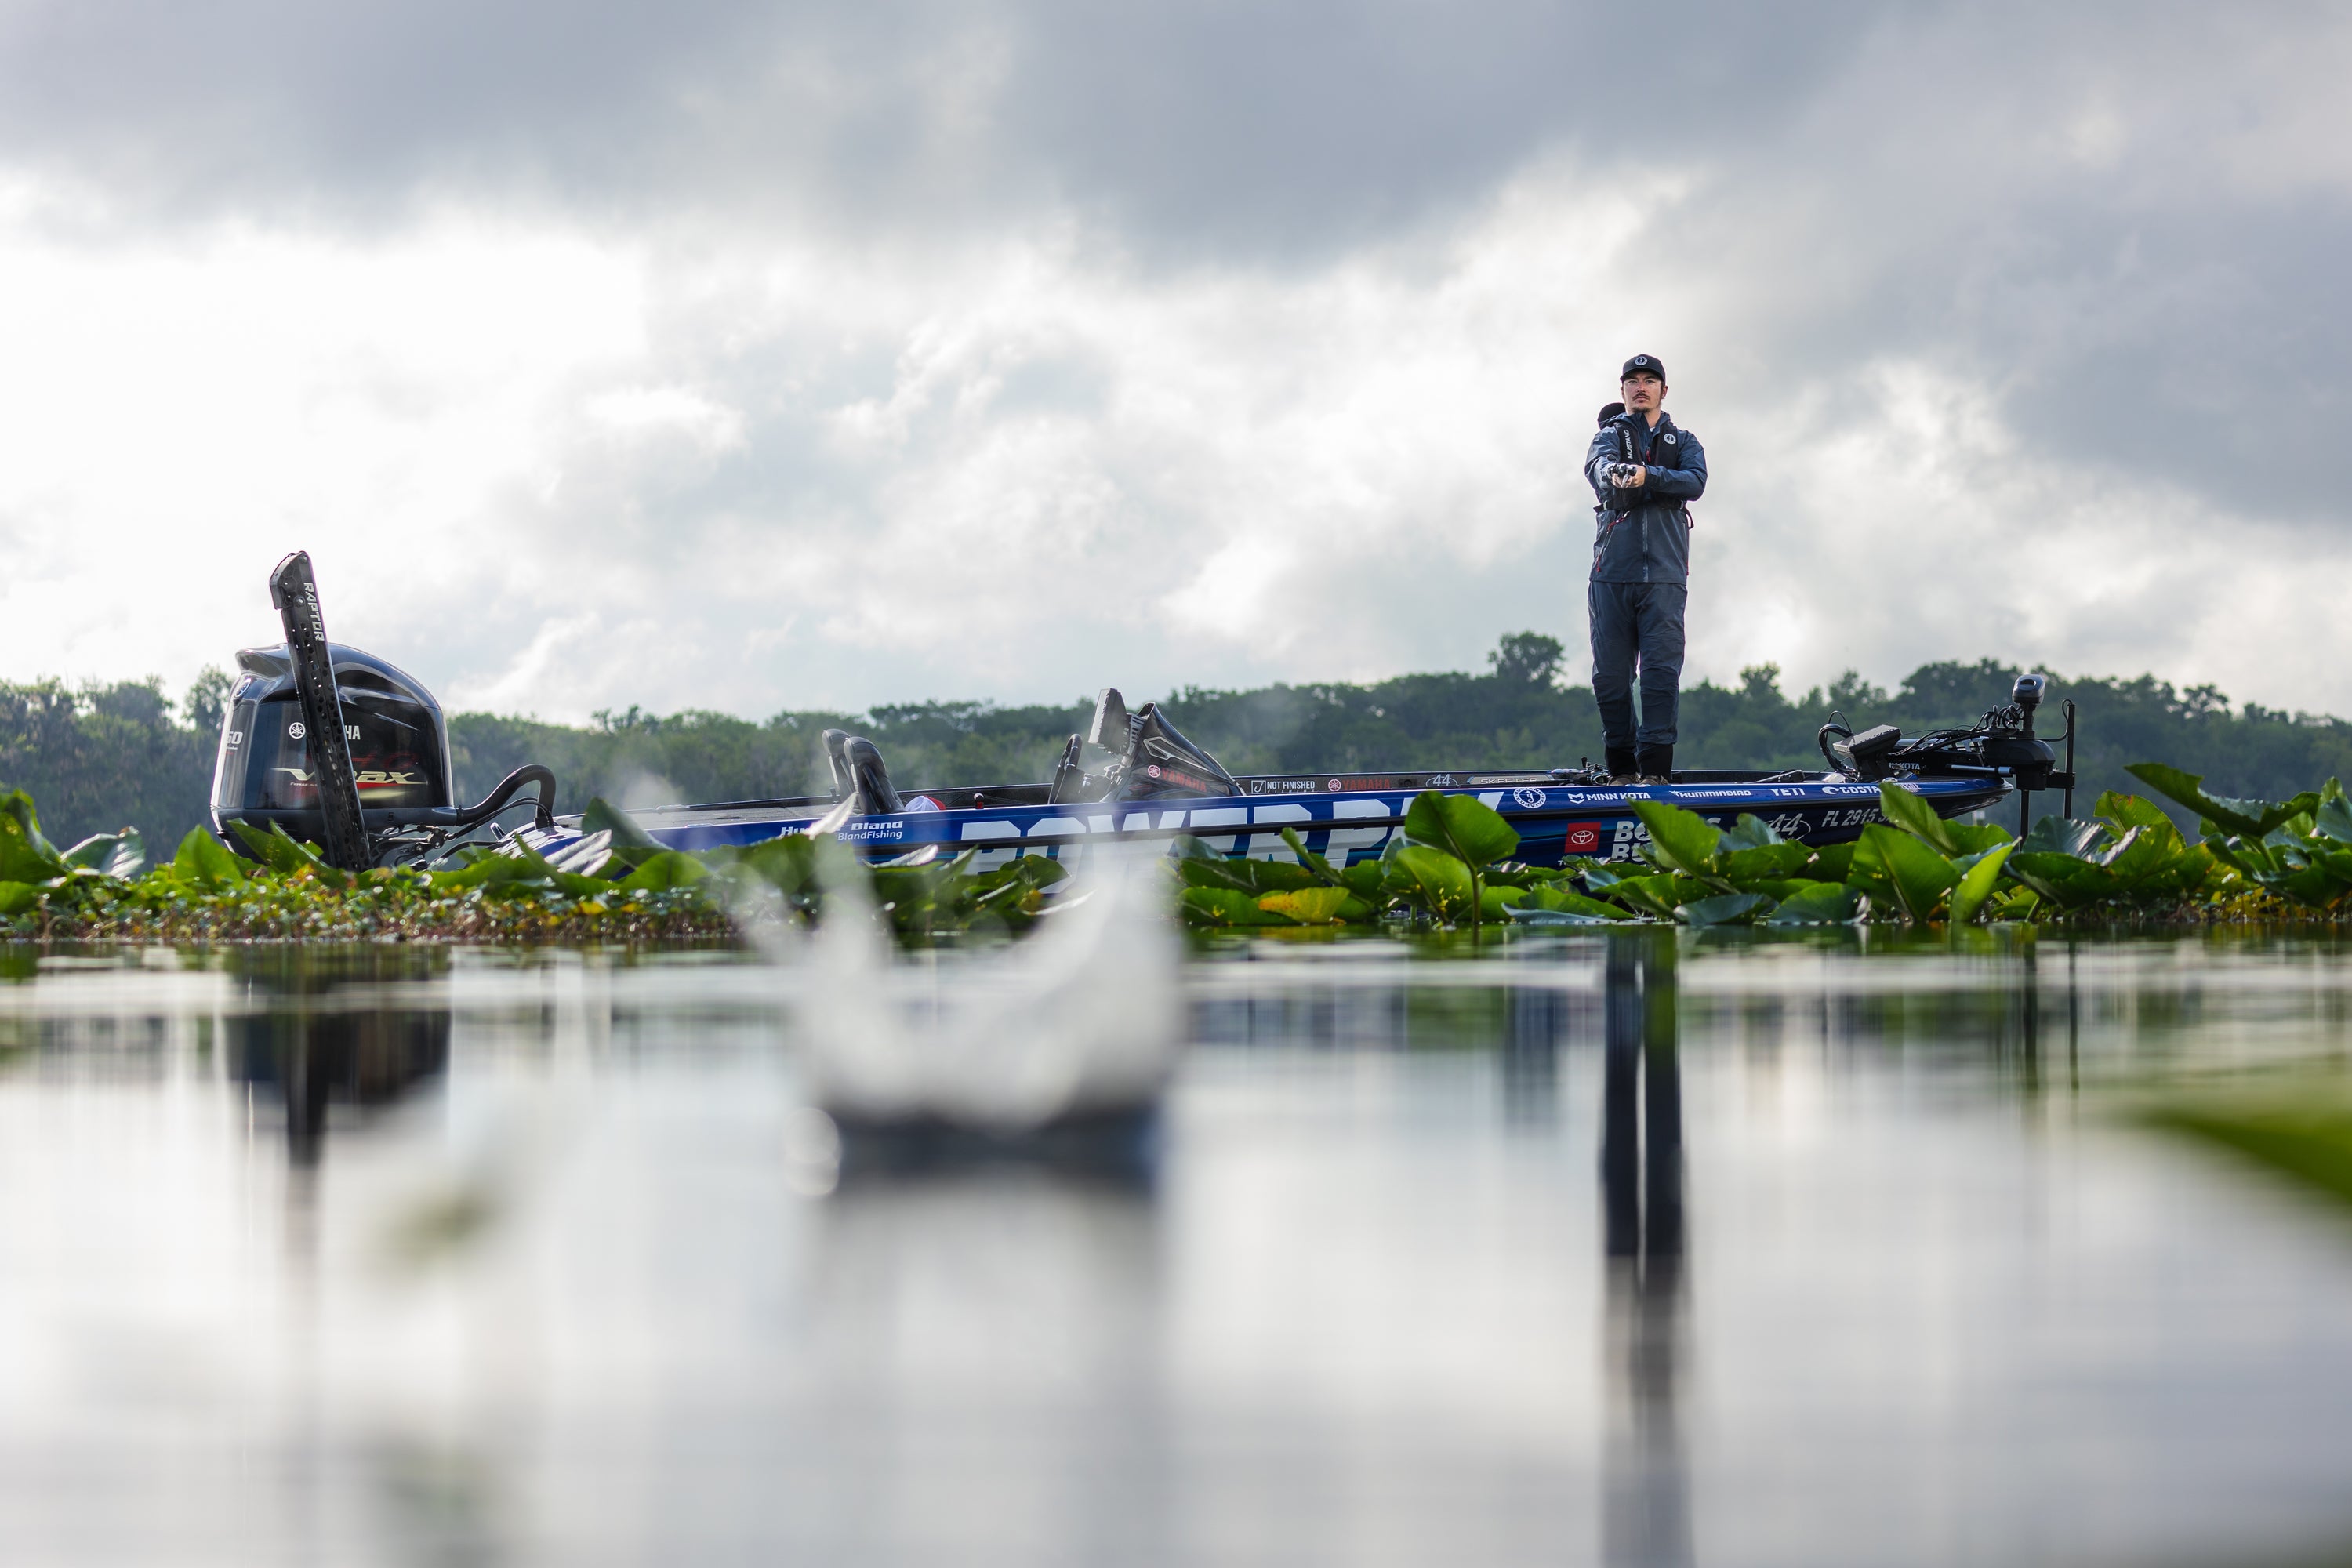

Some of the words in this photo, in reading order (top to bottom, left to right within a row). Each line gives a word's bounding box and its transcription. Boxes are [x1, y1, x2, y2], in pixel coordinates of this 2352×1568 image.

[1623, 430, 1633, 459] MUSTANG
[303, 583, 325, 641] RAPTOR
[1162, 768, 1207, 793] YAMAHA
[1267, 781, 1282, 790] NOT
[1283, 780, 1316, 789] FINISHED
[1341, 778, 1391, 792] YAMAHA
[1432, 774, 1450, 787] 44
[1769, 787, 1806, 797] YETI
[1842, 786, 1882, 794] COSTA
[1586, 793, 1619, 801] MINN
[1769, 812, 1803, 836] 44
[1821, 810, 1839, 828] FL
[1841, 808, 1880, 826] 2915
[851, 821, 904, 831] Bland
[837, 830, 903, 841] BlandFishing
